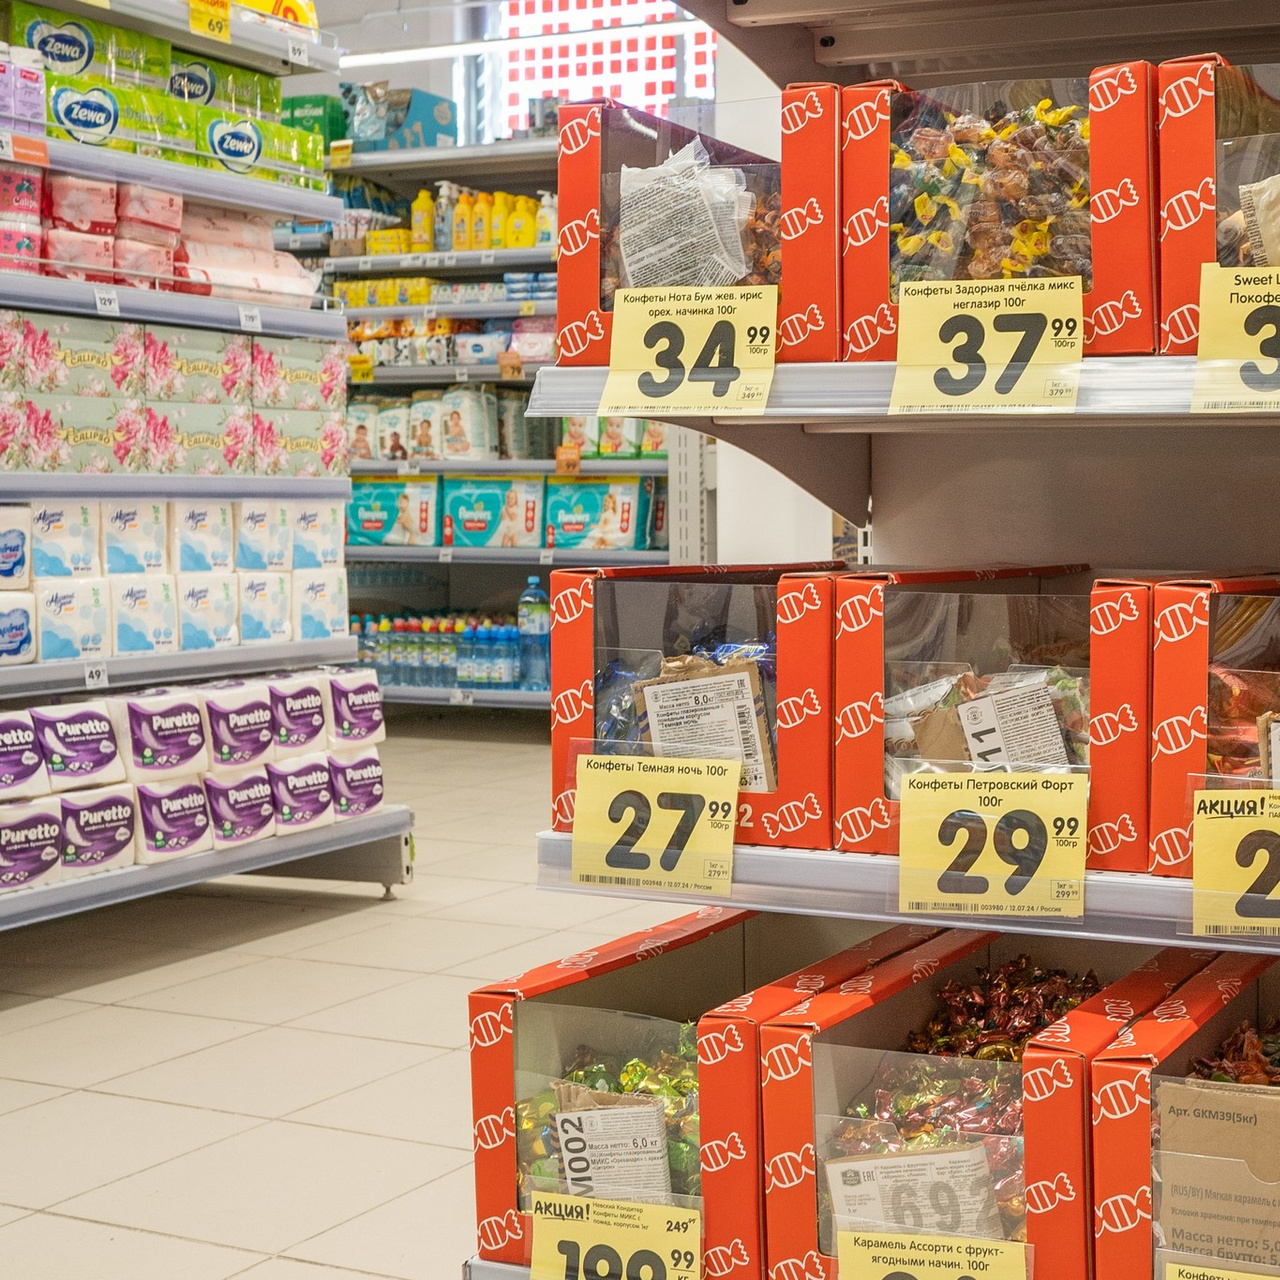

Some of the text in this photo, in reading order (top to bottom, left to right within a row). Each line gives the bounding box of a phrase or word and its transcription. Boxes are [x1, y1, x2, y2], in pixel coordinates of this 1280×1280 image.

[208, 19, 223, 33] 69
[45, 38, 82, 60] Zewa
[71, 104, 107, 125] Zewa
[1234, 274, 1273, 286] Sweet
[904, 281, 1075, 297] Конфеты Задорная пчёлка микс
[624, 292, 762, 304] Конфеты Нота Бум жев. ирис
[953, 298, 1026, 310] неглазир 100г
[649, 308, 673, 317] орех.
[717, 306, 737, 315] 100г
[638, 320, 740, 398] 34
[934, 313, 1077, 396] 37 99
[73, 432, 110, 444] CALIPSO
[89, 671, 101, 680] 49
[153, 712, 199, 730] Puretto
[587, 759, 728, 776] Конфеты Темная ночь 100г
[908, 779, 1074, 792] Конфеты Петровский Форт
[979, 796, 1003, 807] 100г
[80, 805, 131, 825] Puretto
[1, 824, 59, 844] Puretto
[605, 790, 731, 871] 27 99
[937, 810, 1048, 895] 29
[1168, 1105, 1257, 1126] Арт. GKM39(5кг)
[535, 1201, 590, 1220] АКЦИЯ!
[854, 1237, 1004, 1257] Карамель Ассорти с фрукт-
[872, 1256, 990, 1271] ягодными начин. 100г
